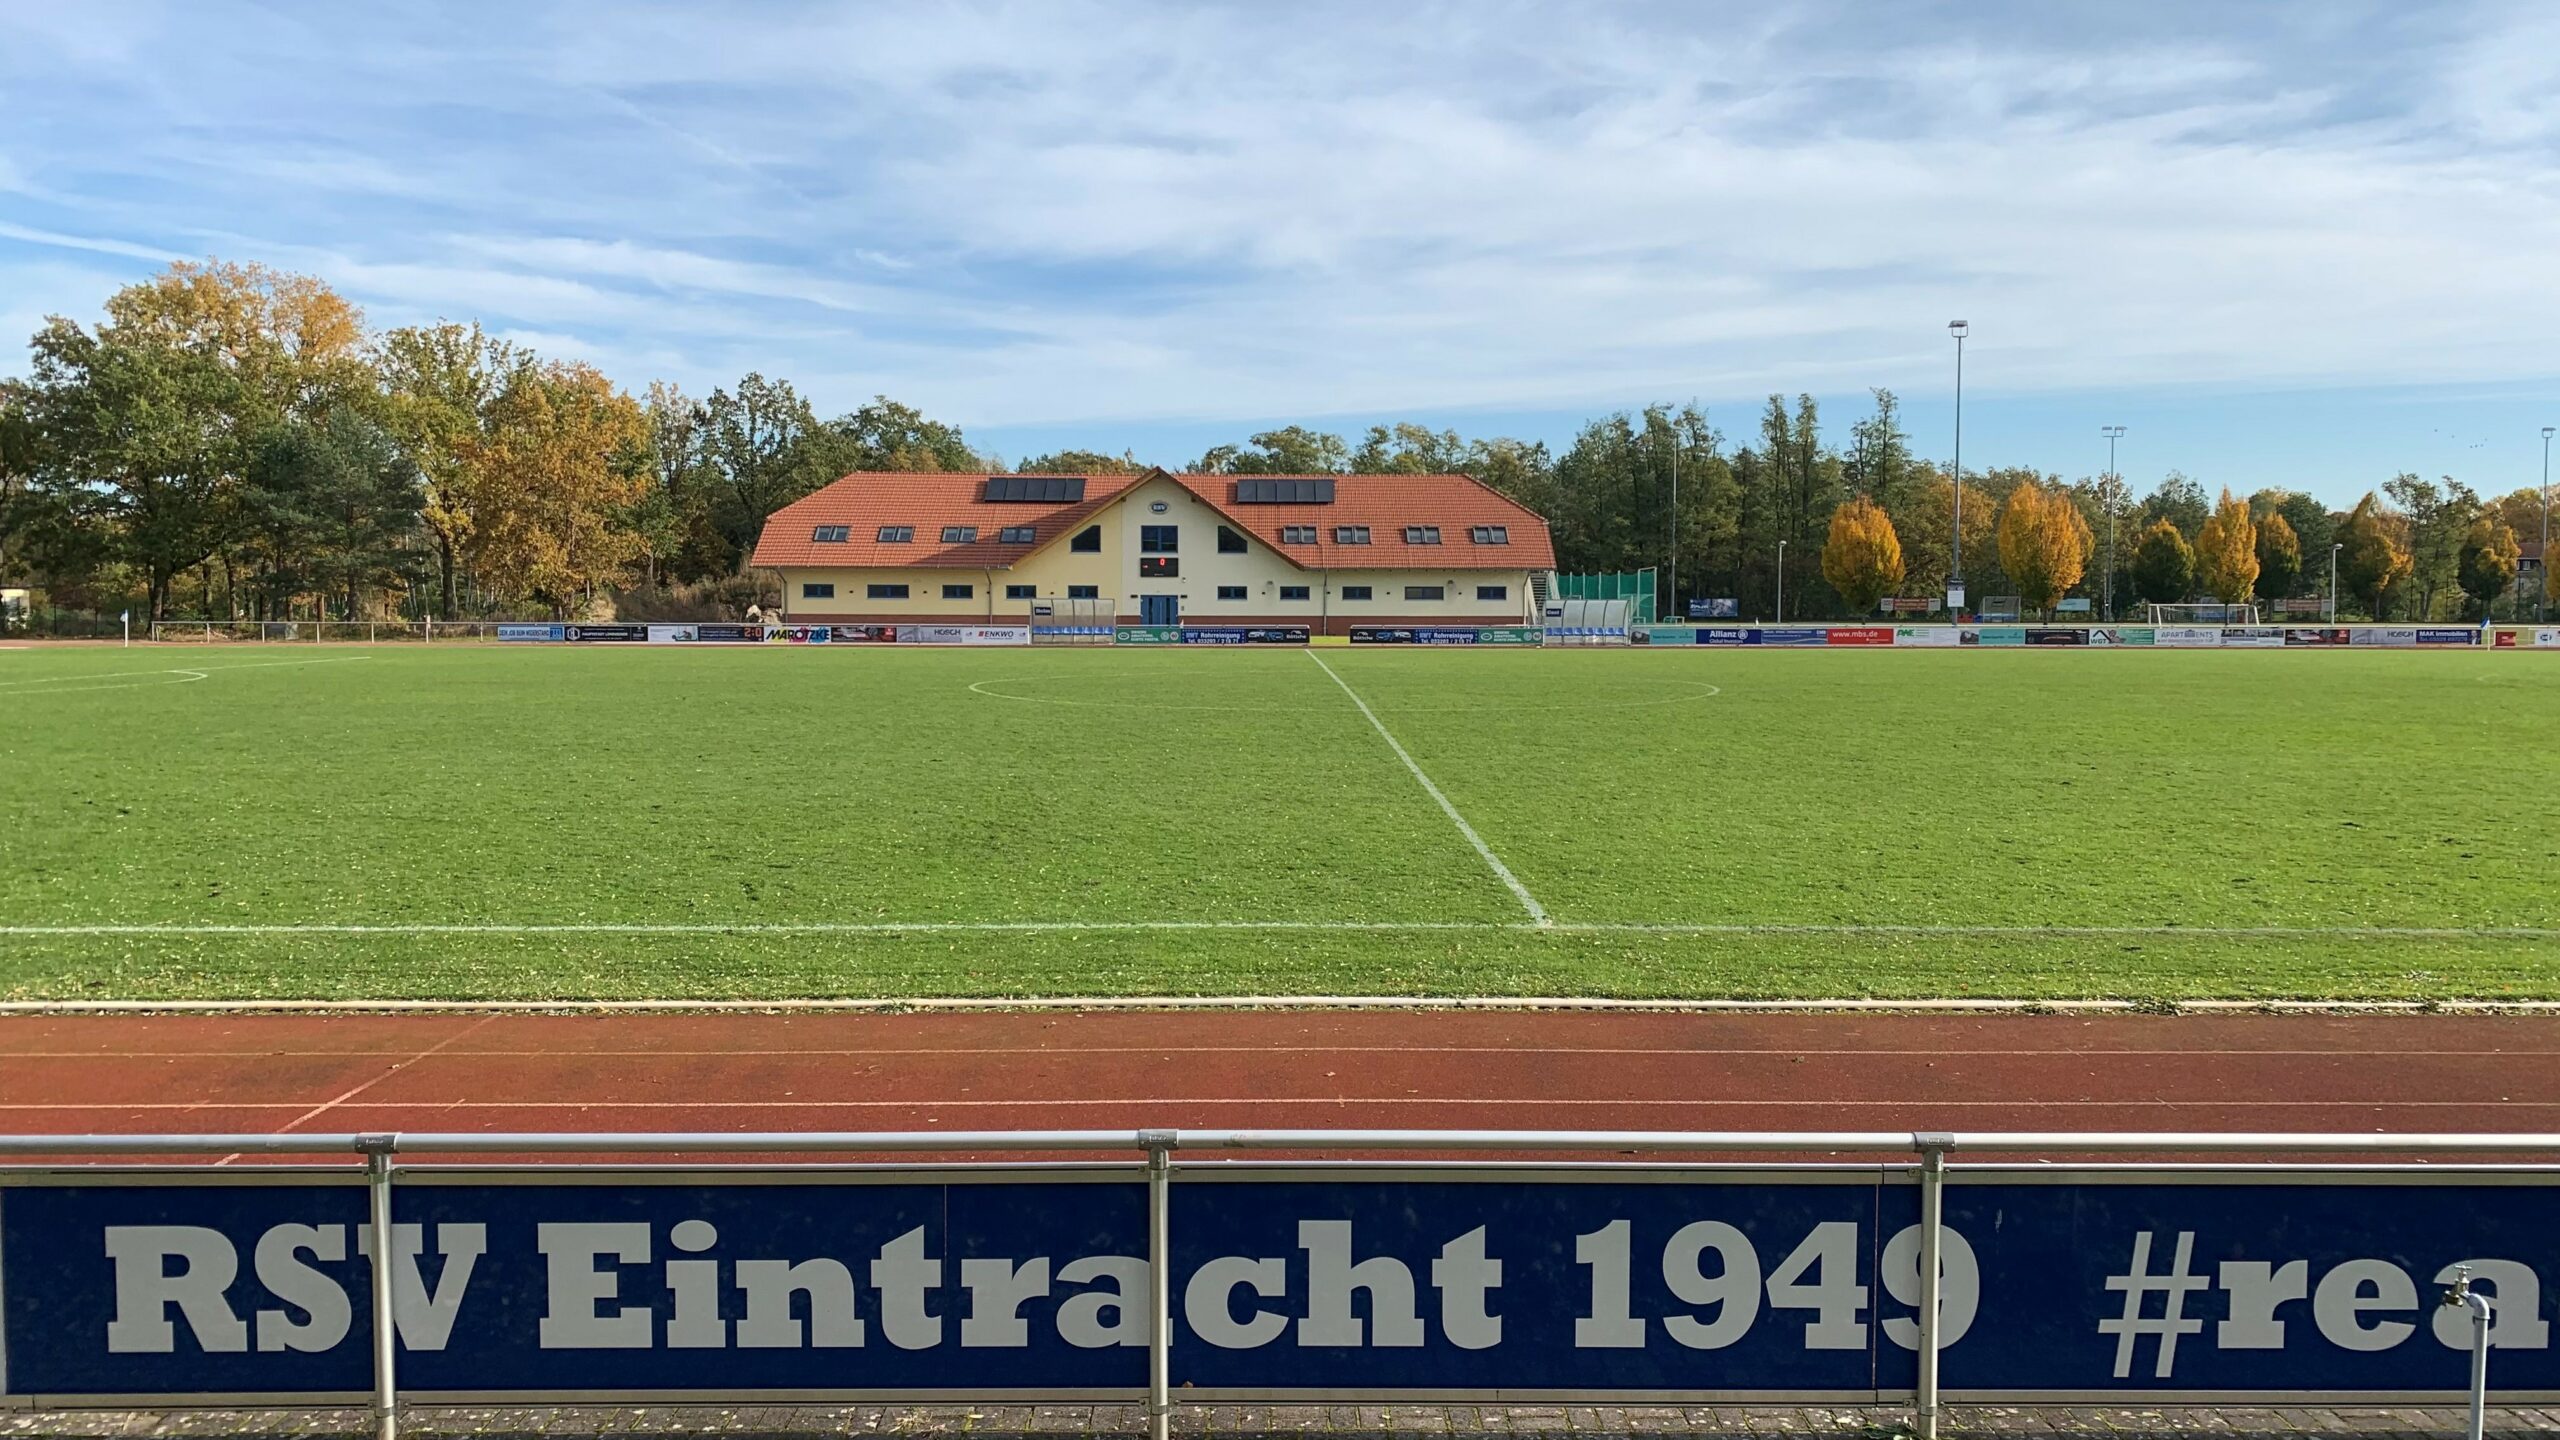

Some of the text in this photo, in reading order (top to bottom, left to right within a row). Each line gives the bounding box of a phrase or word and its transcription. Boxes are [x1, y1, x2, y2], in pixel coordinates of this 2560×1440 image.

[766, 629, 830, 640] MAROTZKE
[1200, 632, 1240, 640] Rohrreinigung
[1433, 632, 1473, 640] Rohrreinigung
[1709, 630, 1737, 638] Allianz
[1832, 630, 1878, 638] www.mbs.de
[105, 1219, 2550, 1379] RSV Eintracht 1949 #rea
